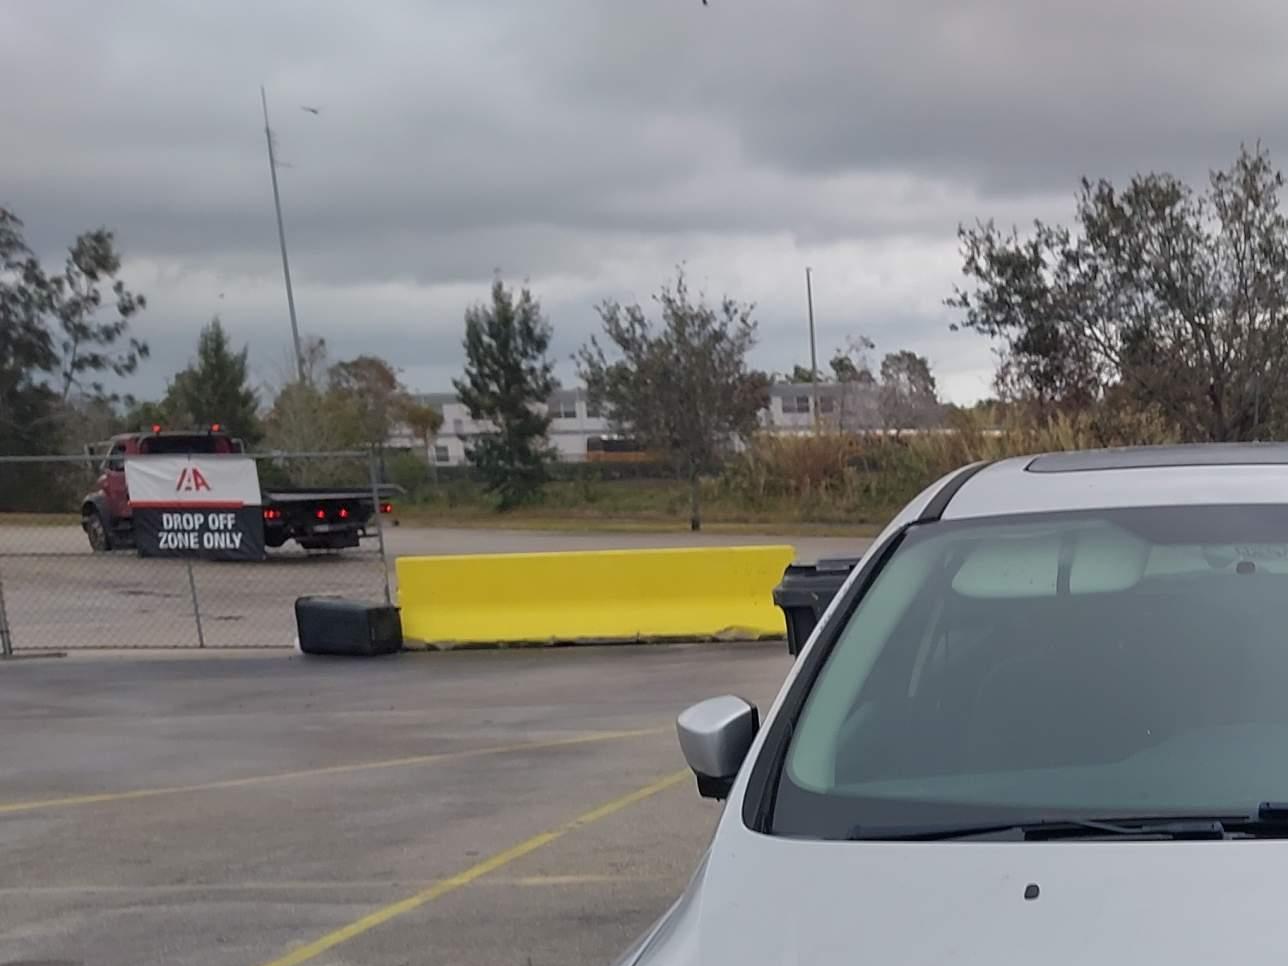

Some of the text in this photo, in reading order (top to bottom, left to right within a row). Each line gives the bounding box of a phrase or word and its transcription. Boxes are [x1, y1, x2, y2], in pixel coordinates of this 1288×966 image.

[162, 513, 236, 530] DROP OFF
[158, 532, 243, 549] ZONE ONLY
